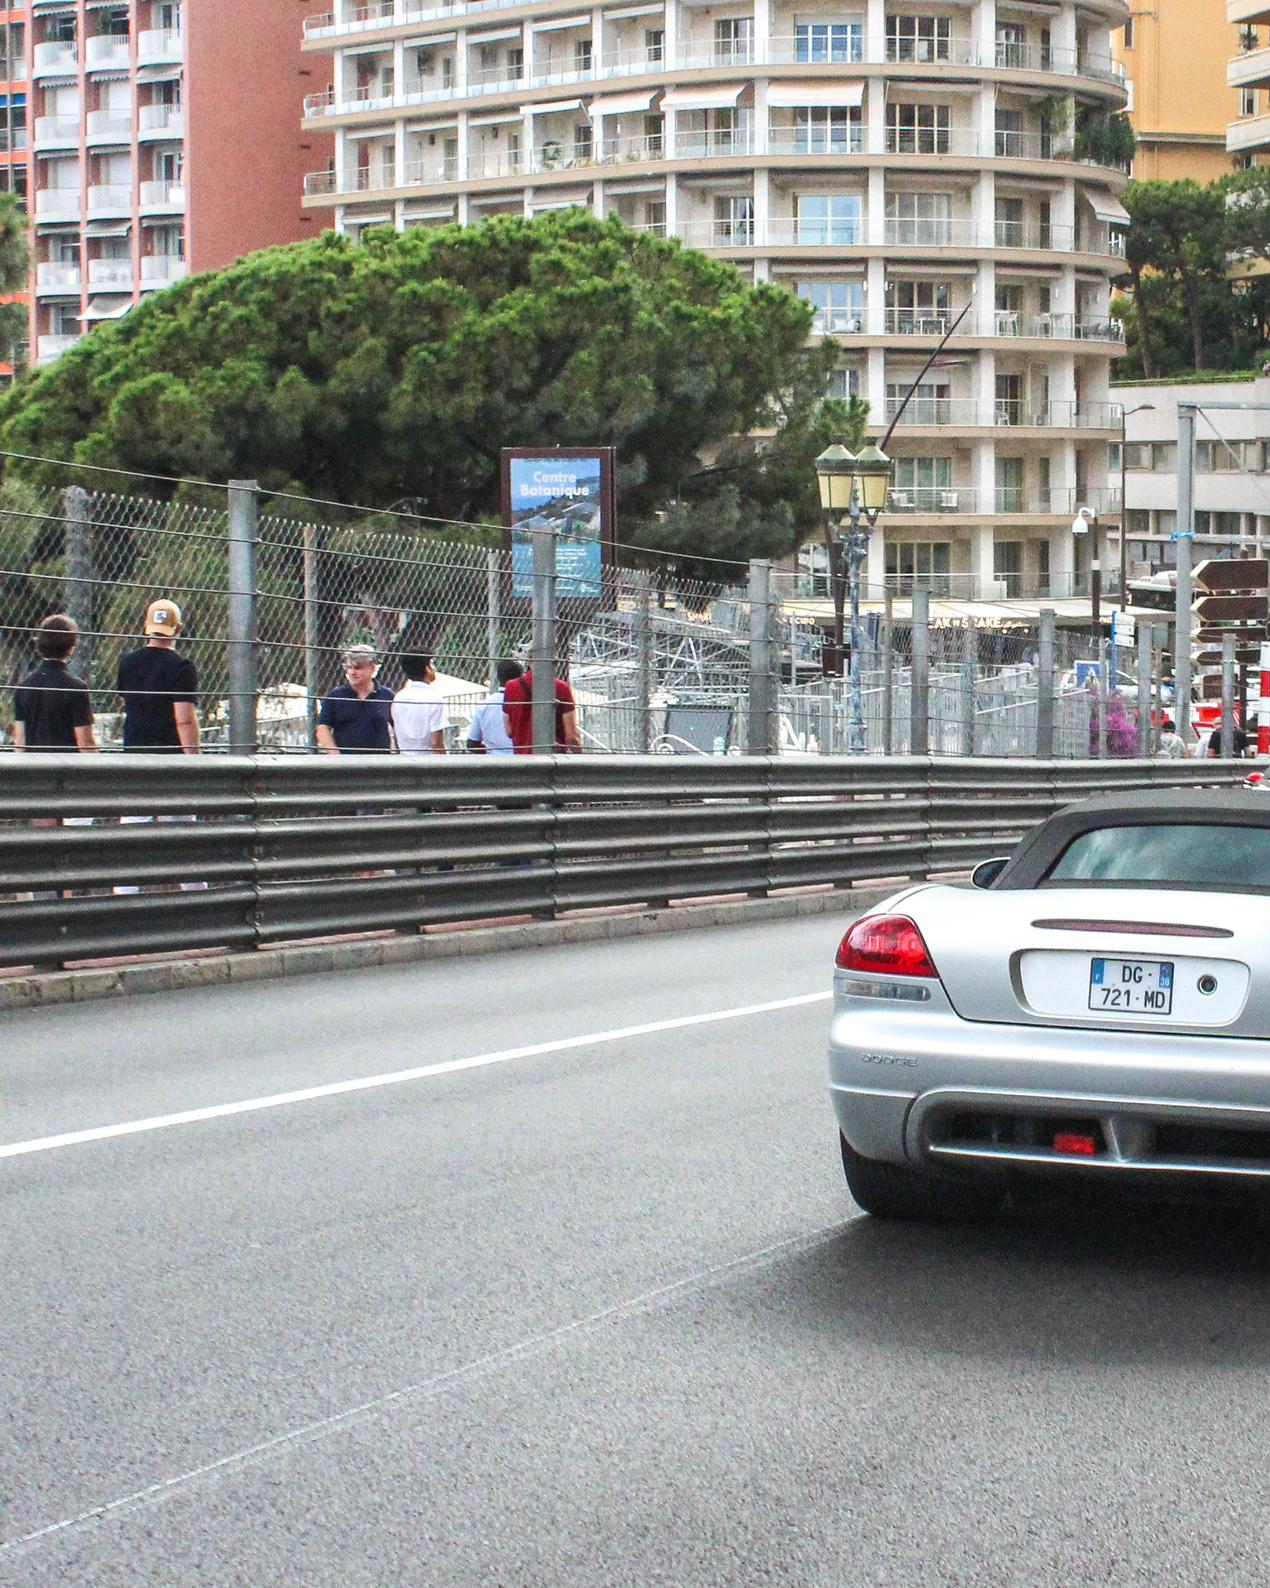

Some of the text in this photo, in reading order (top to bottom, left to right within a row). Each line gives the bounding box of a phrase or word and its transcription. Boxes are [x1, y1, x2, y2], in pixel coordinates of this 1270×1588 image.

[533, 471, 577, 483] Centre
[520, 484, 590, 499] Botanique
[1160, 977, 1170, 987] 38
[862, 1053, 918, 1067] DODGE
